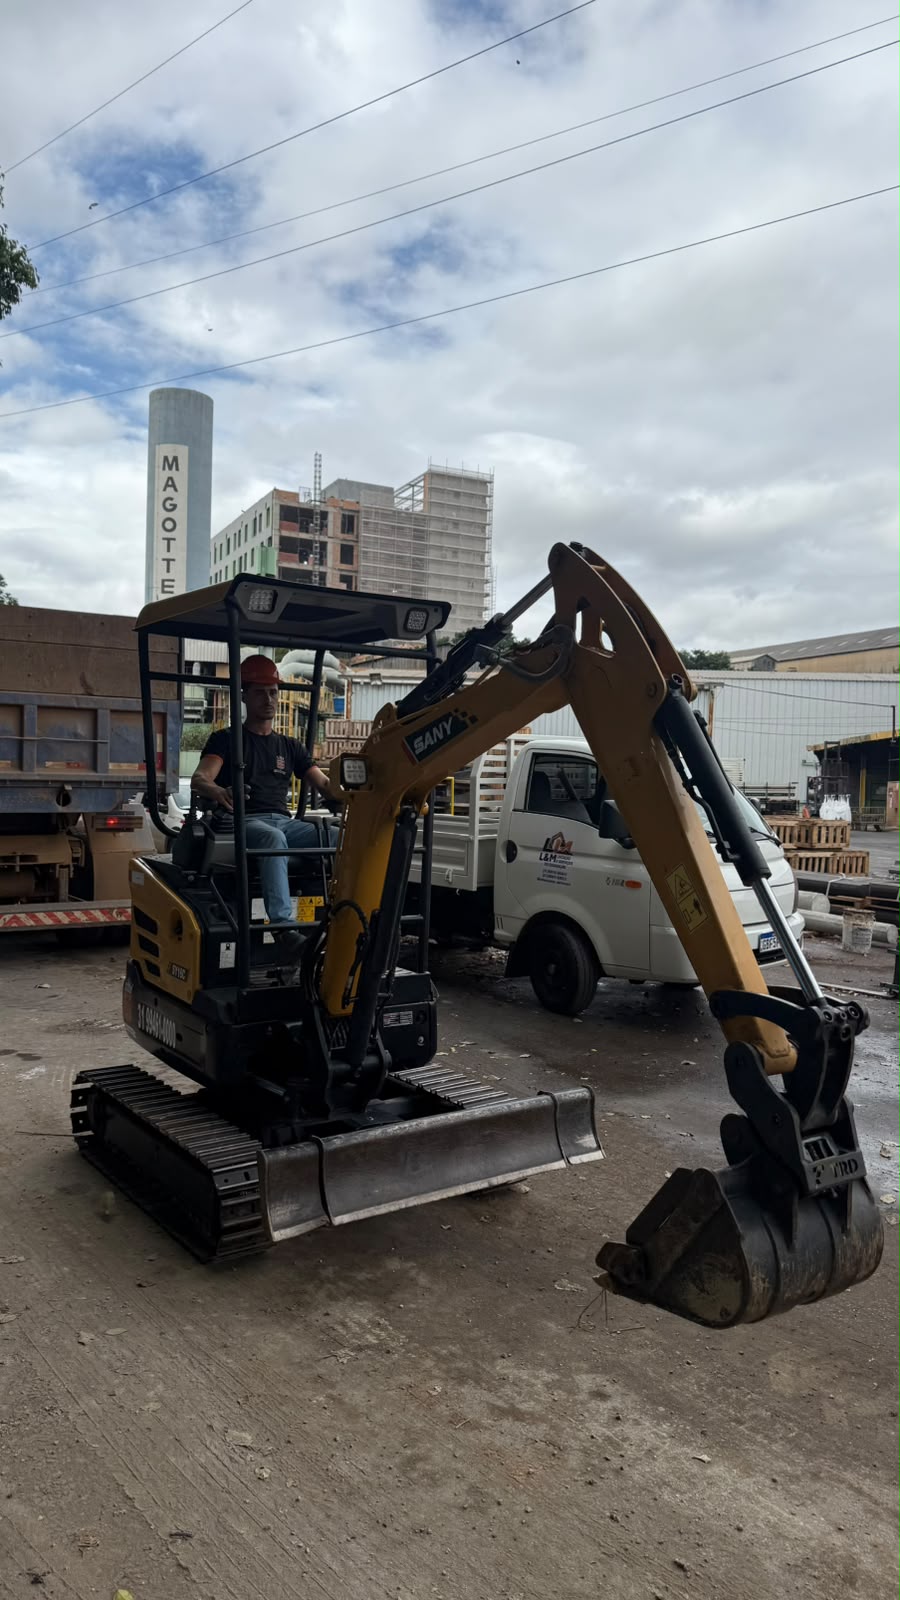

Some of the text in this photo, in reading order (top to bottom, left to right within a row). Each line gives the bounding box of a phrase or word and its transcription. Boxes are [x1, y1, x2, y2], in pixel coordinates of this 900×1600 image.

[413, 716, 453, 755] SANY
[539, 852, 557, 863] L&M
[137, 1001, 145, 1031] 31
